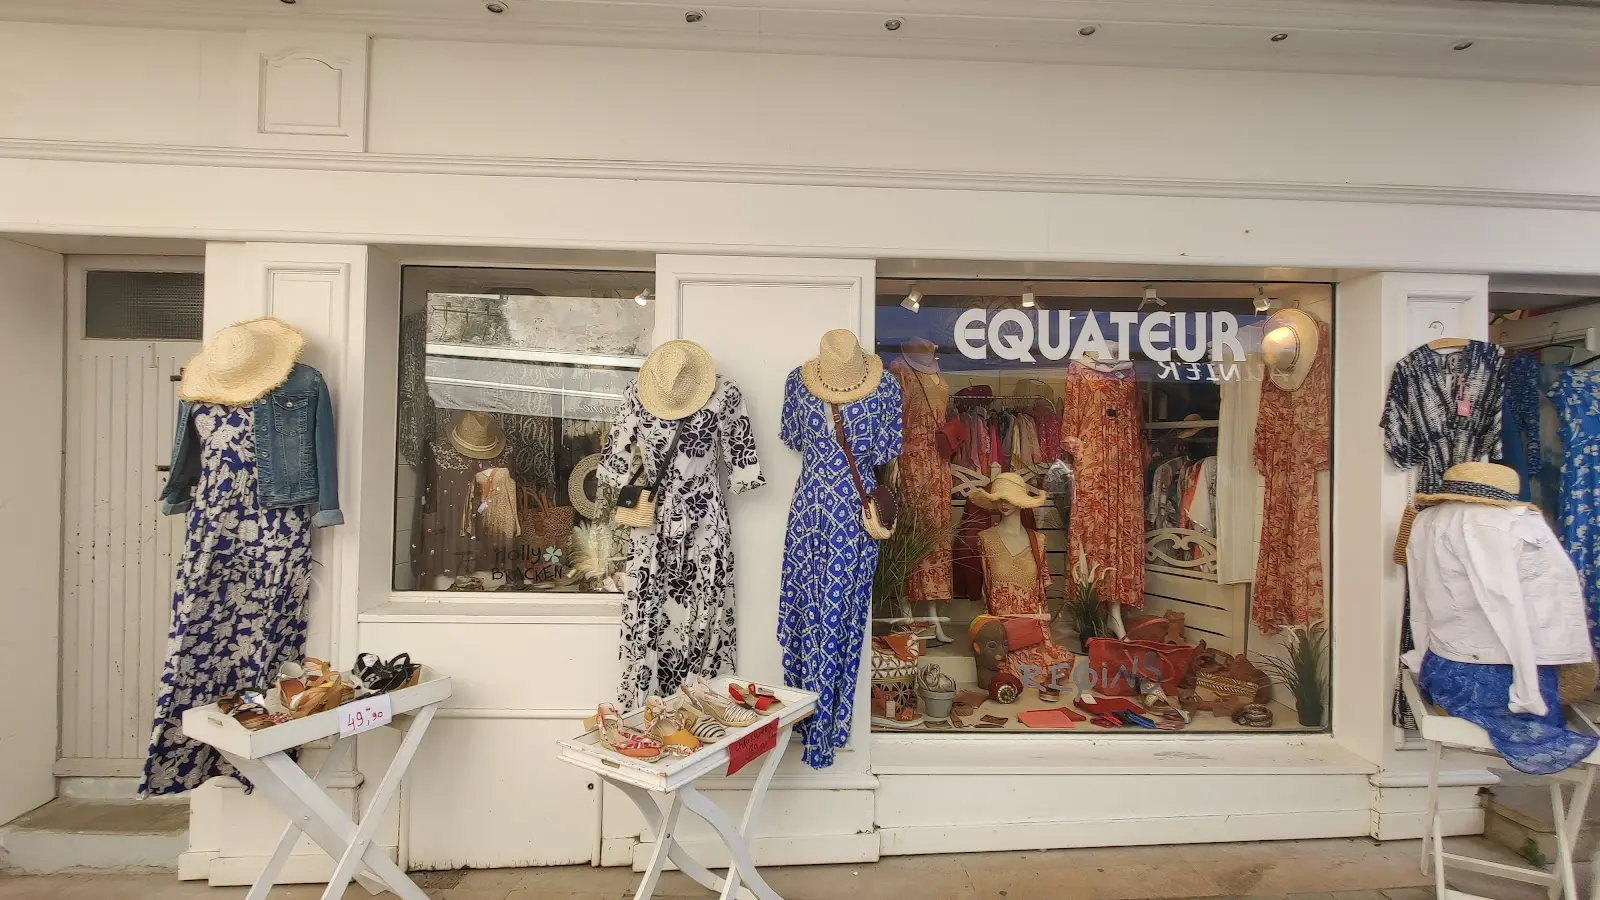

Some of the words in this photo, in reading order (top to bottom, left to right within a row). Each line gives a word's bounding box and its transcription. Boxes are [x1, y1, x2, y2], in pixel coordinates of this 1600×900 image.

[953, 308, 1246, 362] EQUATEUR
[495, 544, 541, 564] Holly
[491, 564, 563, 581] BRACKEN
